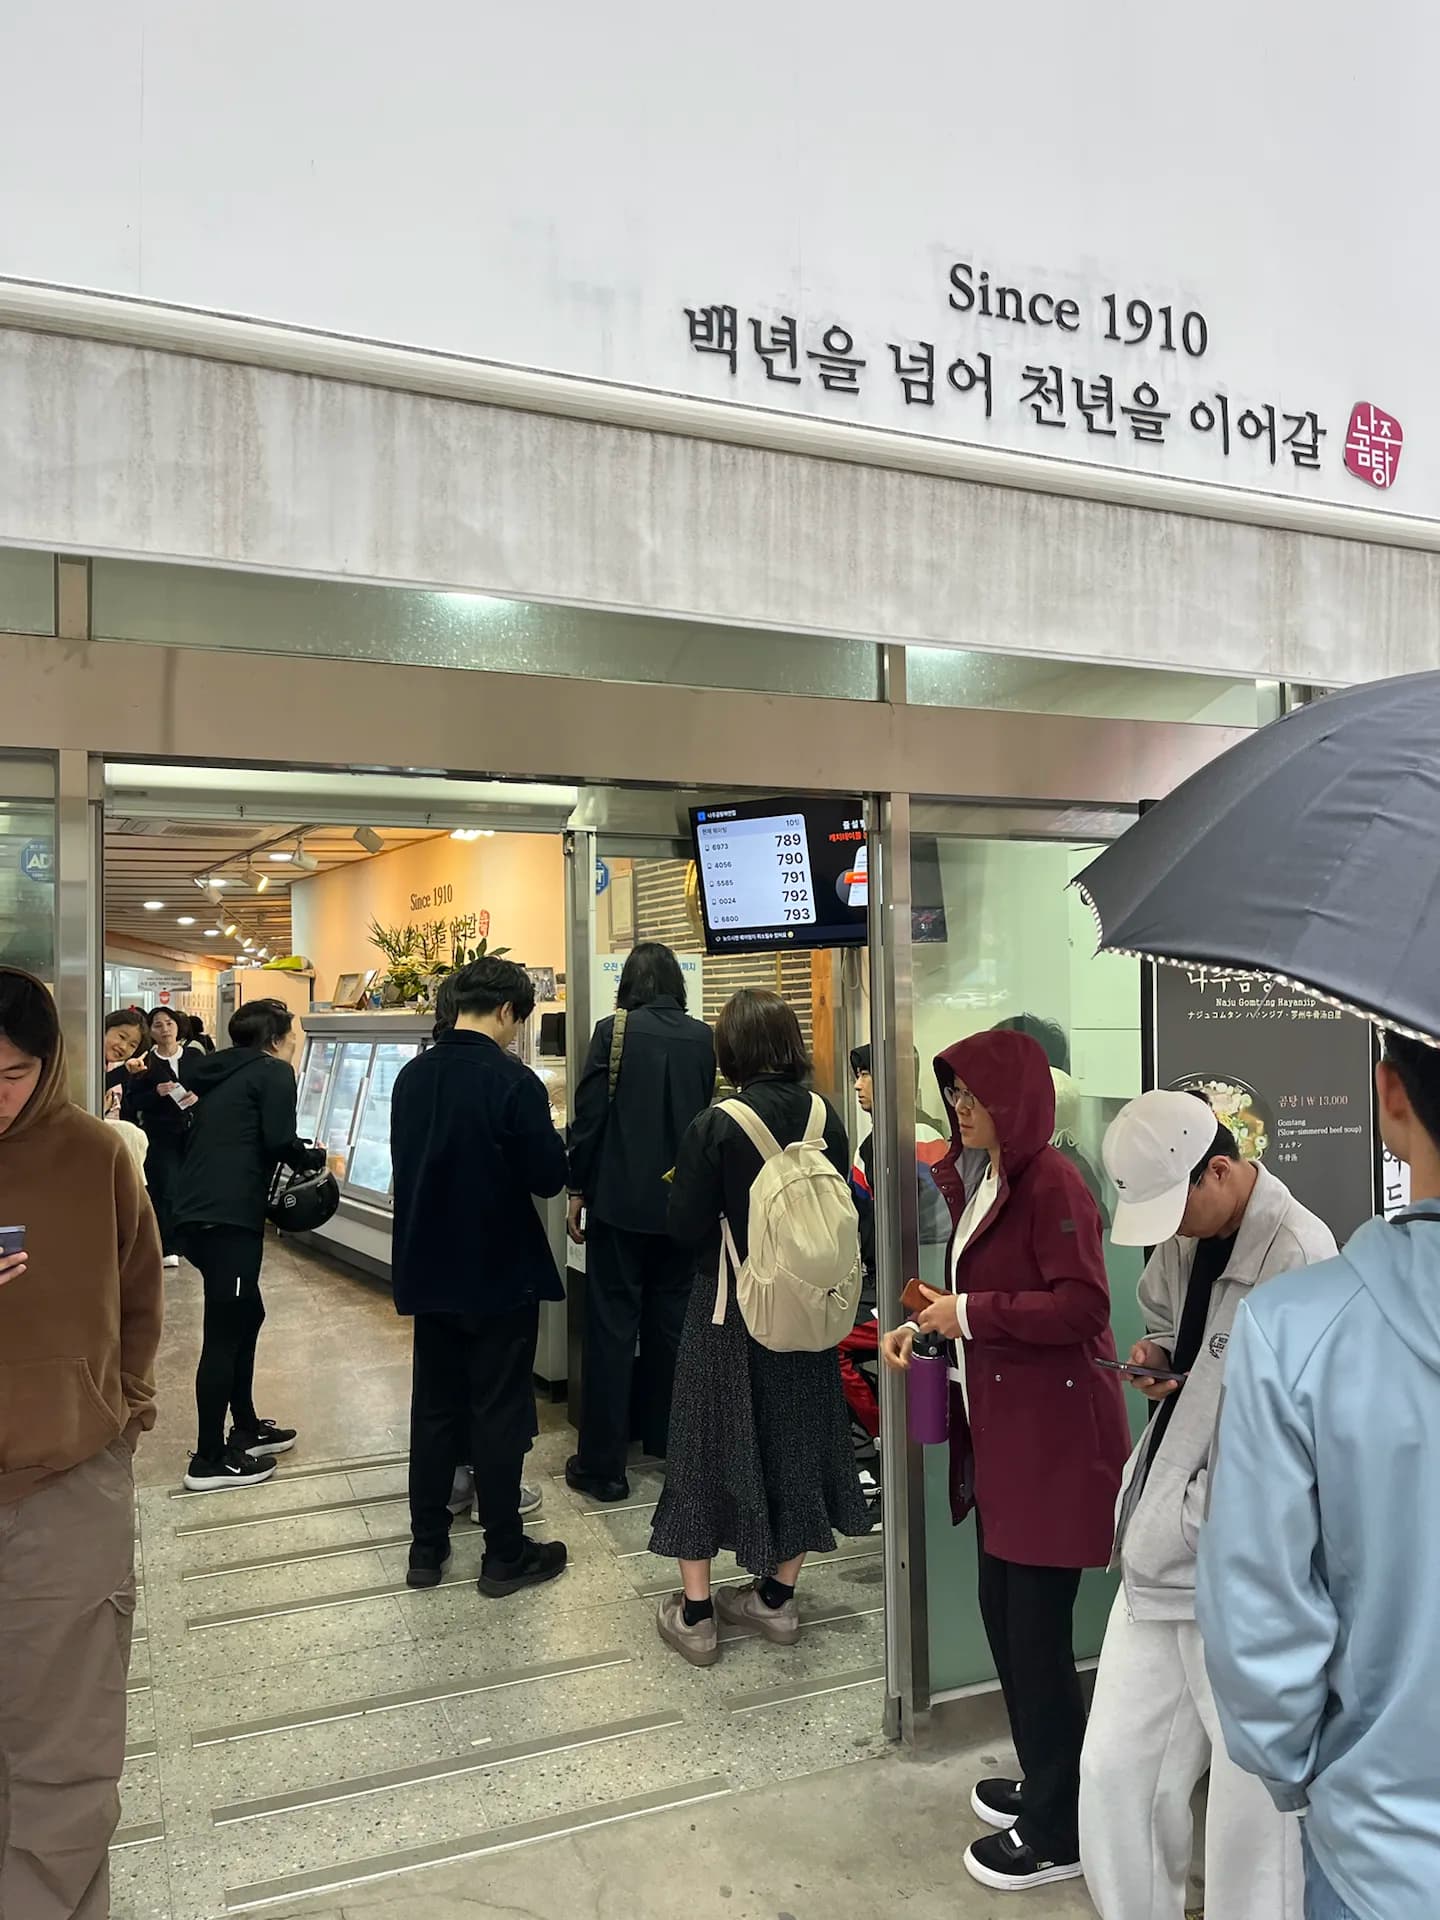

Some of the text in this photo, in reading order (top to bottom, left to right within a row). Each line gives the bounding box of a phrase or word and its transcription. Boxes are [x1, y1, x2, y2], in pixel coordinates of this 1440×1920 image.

[948, 263, 1208, 357] Since 1910
[683, 304, 1327, 470] 백년을 넘어 천년을 이어갈
[774, 833, 801, 848] 789
[27, 853, 54, 868] AD
[776, 852, 803, 866] 790
[781, 871, 805, 884] 791
[410, 884, 453, 911] Since 1910
[781, 889, 808, 903] 792
[783, 908, 810, 921] 793
[1215, 998, 1236, 1007] Naju
[1277, 997, 1317, 1007] Hayanjip
